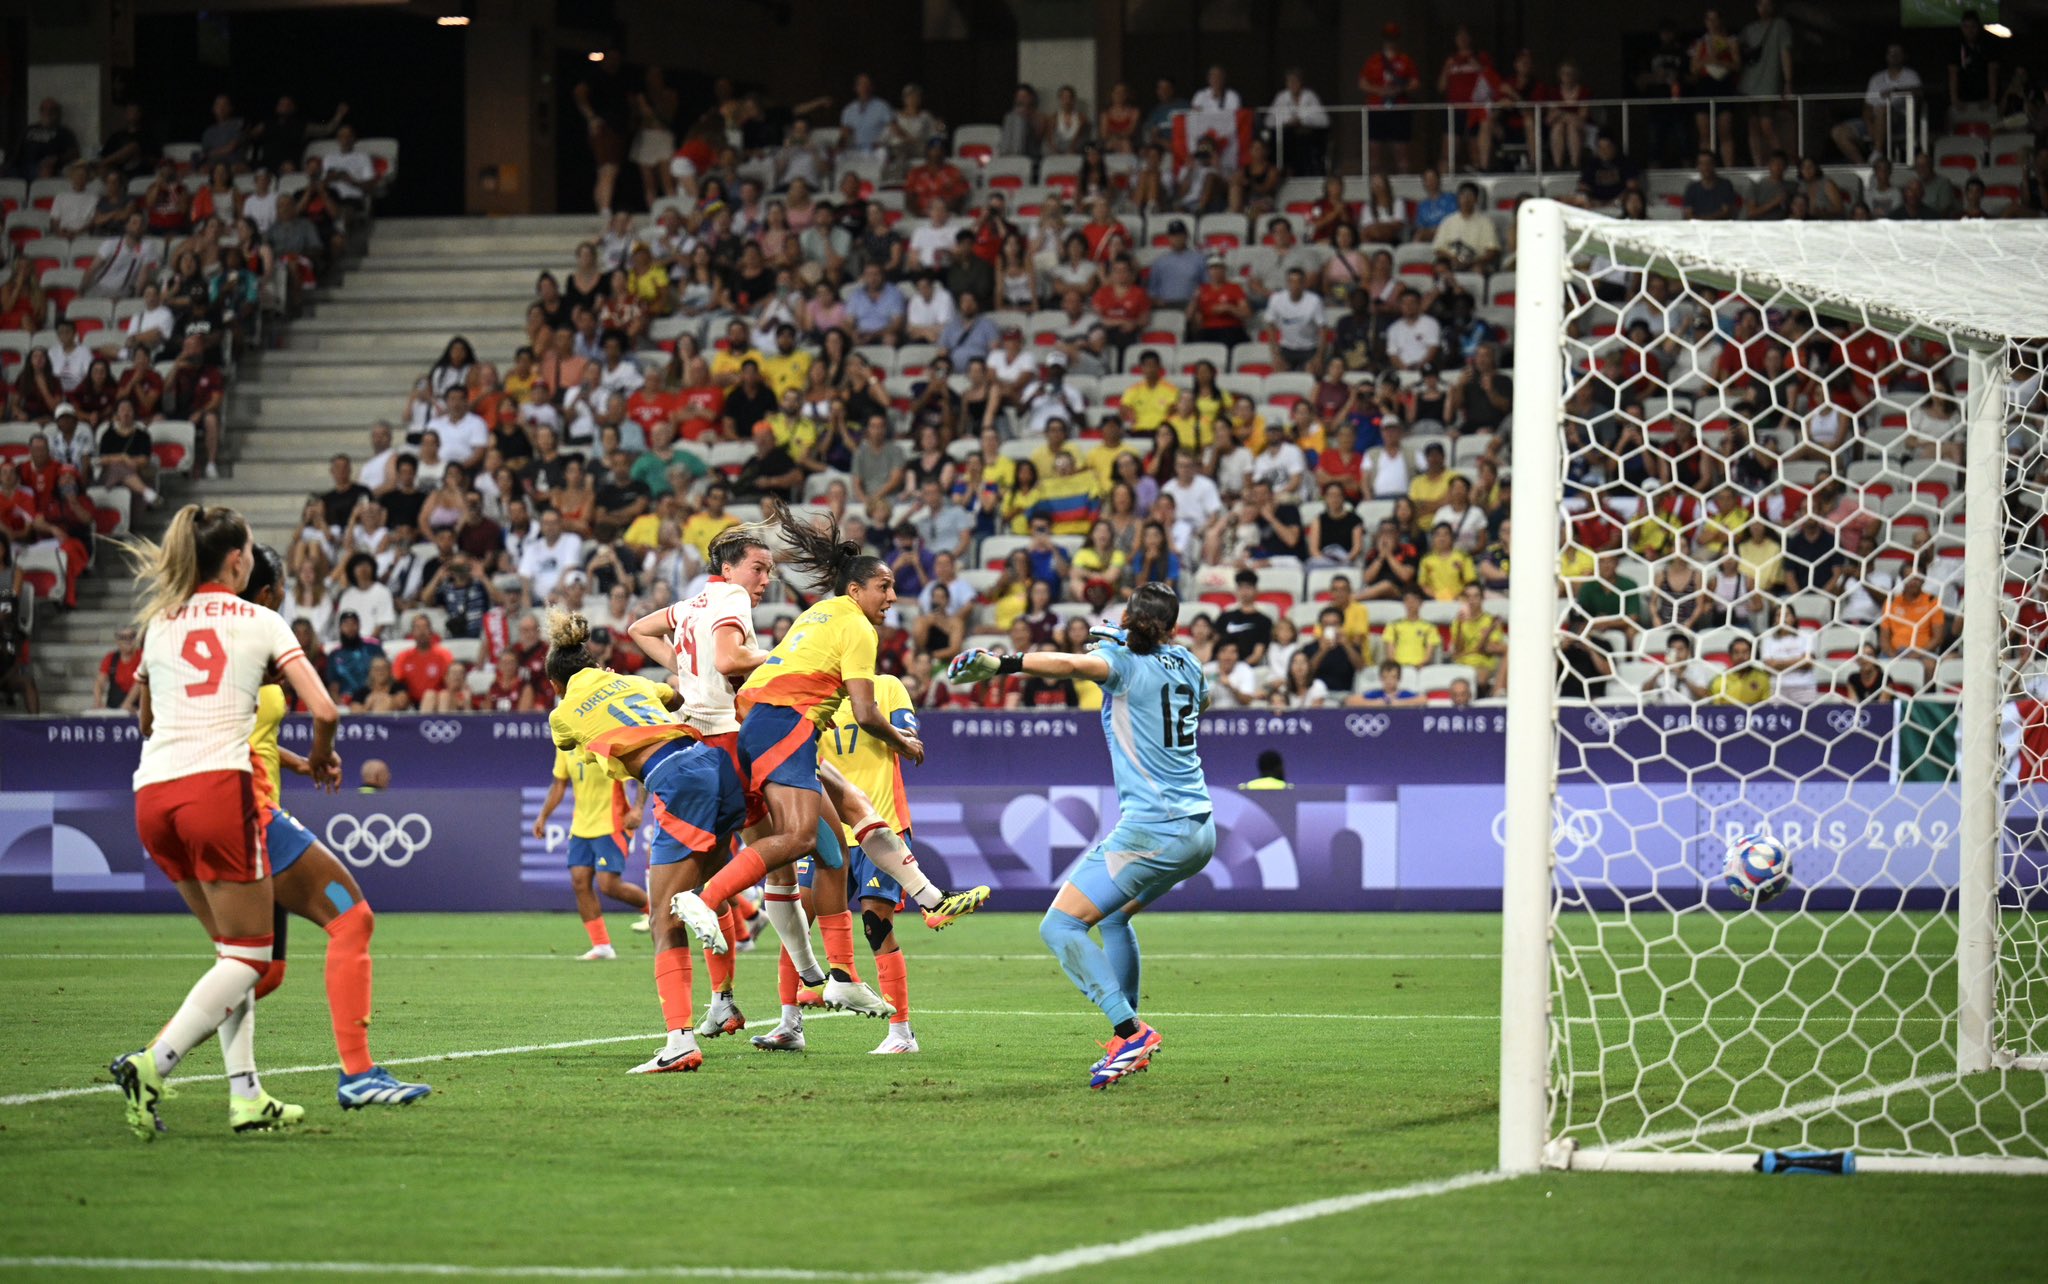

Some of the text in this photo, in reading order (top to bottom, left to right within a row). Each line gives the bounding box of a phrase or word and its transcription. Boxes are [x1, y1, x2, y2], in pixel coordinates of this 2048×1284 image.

[164, 601, 255, 620] UITEMA
[181, 628, 228, 697] 9
[575, 680, 630, 718] JORELYN
[1161, 683, 1195, 748] 12
[1423, 716, 1487, 733] PARIS
[1734, 713, 1792, 731] 2024
[48, 725, 140, 742] PARIS 20
[276, 723, 389, 742] ARI 2024
[493, 722, 551, 739] PARIS
[953, 719, 1078, 737] PARIS 2024
[1200, 716, 1313, 735] ARIS 2024
[833, 724, 859, 755] 17
[1867, 820, 1949, 849] 202
